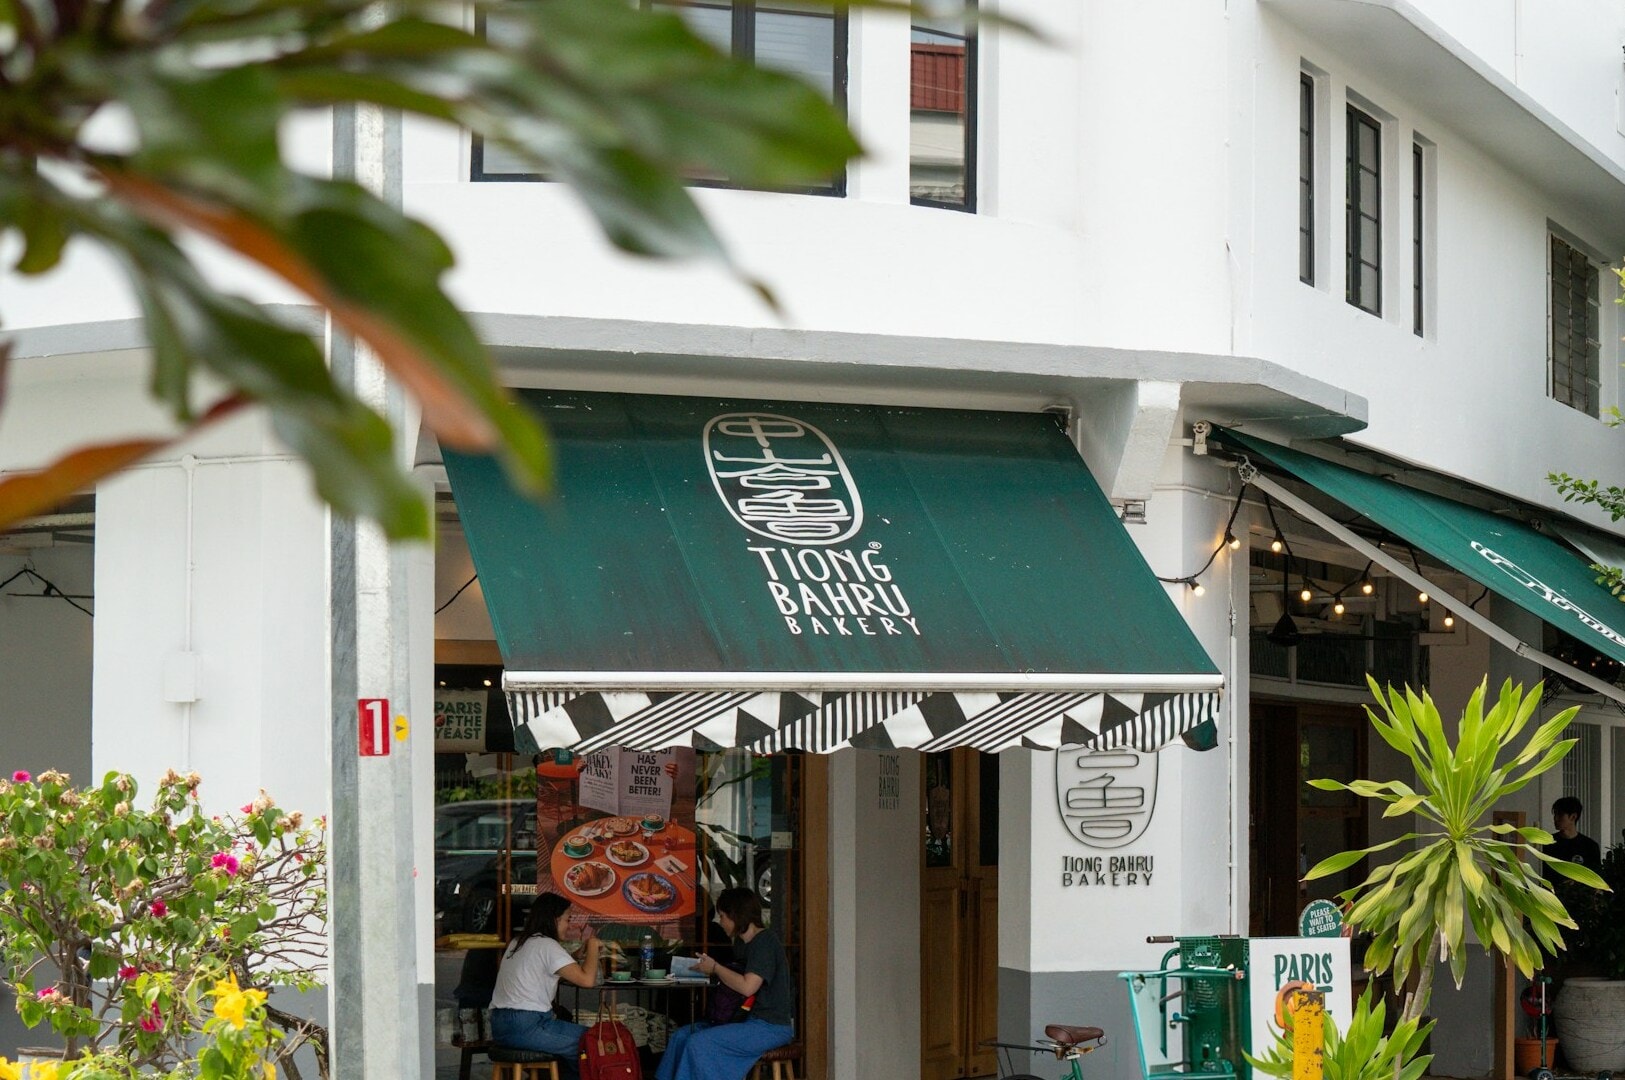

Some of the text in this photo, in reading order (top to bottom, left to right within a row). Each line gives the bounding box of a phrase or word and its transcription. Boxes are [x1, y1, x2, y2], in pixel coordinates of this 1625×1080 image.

[747, 546, 892, 582] TIONG
[767, 581, 911, 616] BAHRU
[785, 616, 921, 635] BAKERY
[435, 702, 482, 714] PARIS
[366, 700, 383, 755] 1
[435, 727, 482, 740] YEAST
[637, 754, 657, 765] HAS
[878, 754, 900, 776] TIONG
[631, 764, 661, 776] NEVER
[634, 776, 657, 786] BEEN
[878, 776, 900, 798] BAHRU
[629, 785, 661, 796] BETTER!
[1062, 855, 1154, 872] TIONG BAHRU
[1062, 872, 1153, 887] BAKERY
[1311, 907, 1329, 918] PLEASE
[1309, 914, 1334, 927] WAIT TO
[1308, 922, 1336, 935] BE SEATED
[1274, 953, 1333, 991] PARIS
